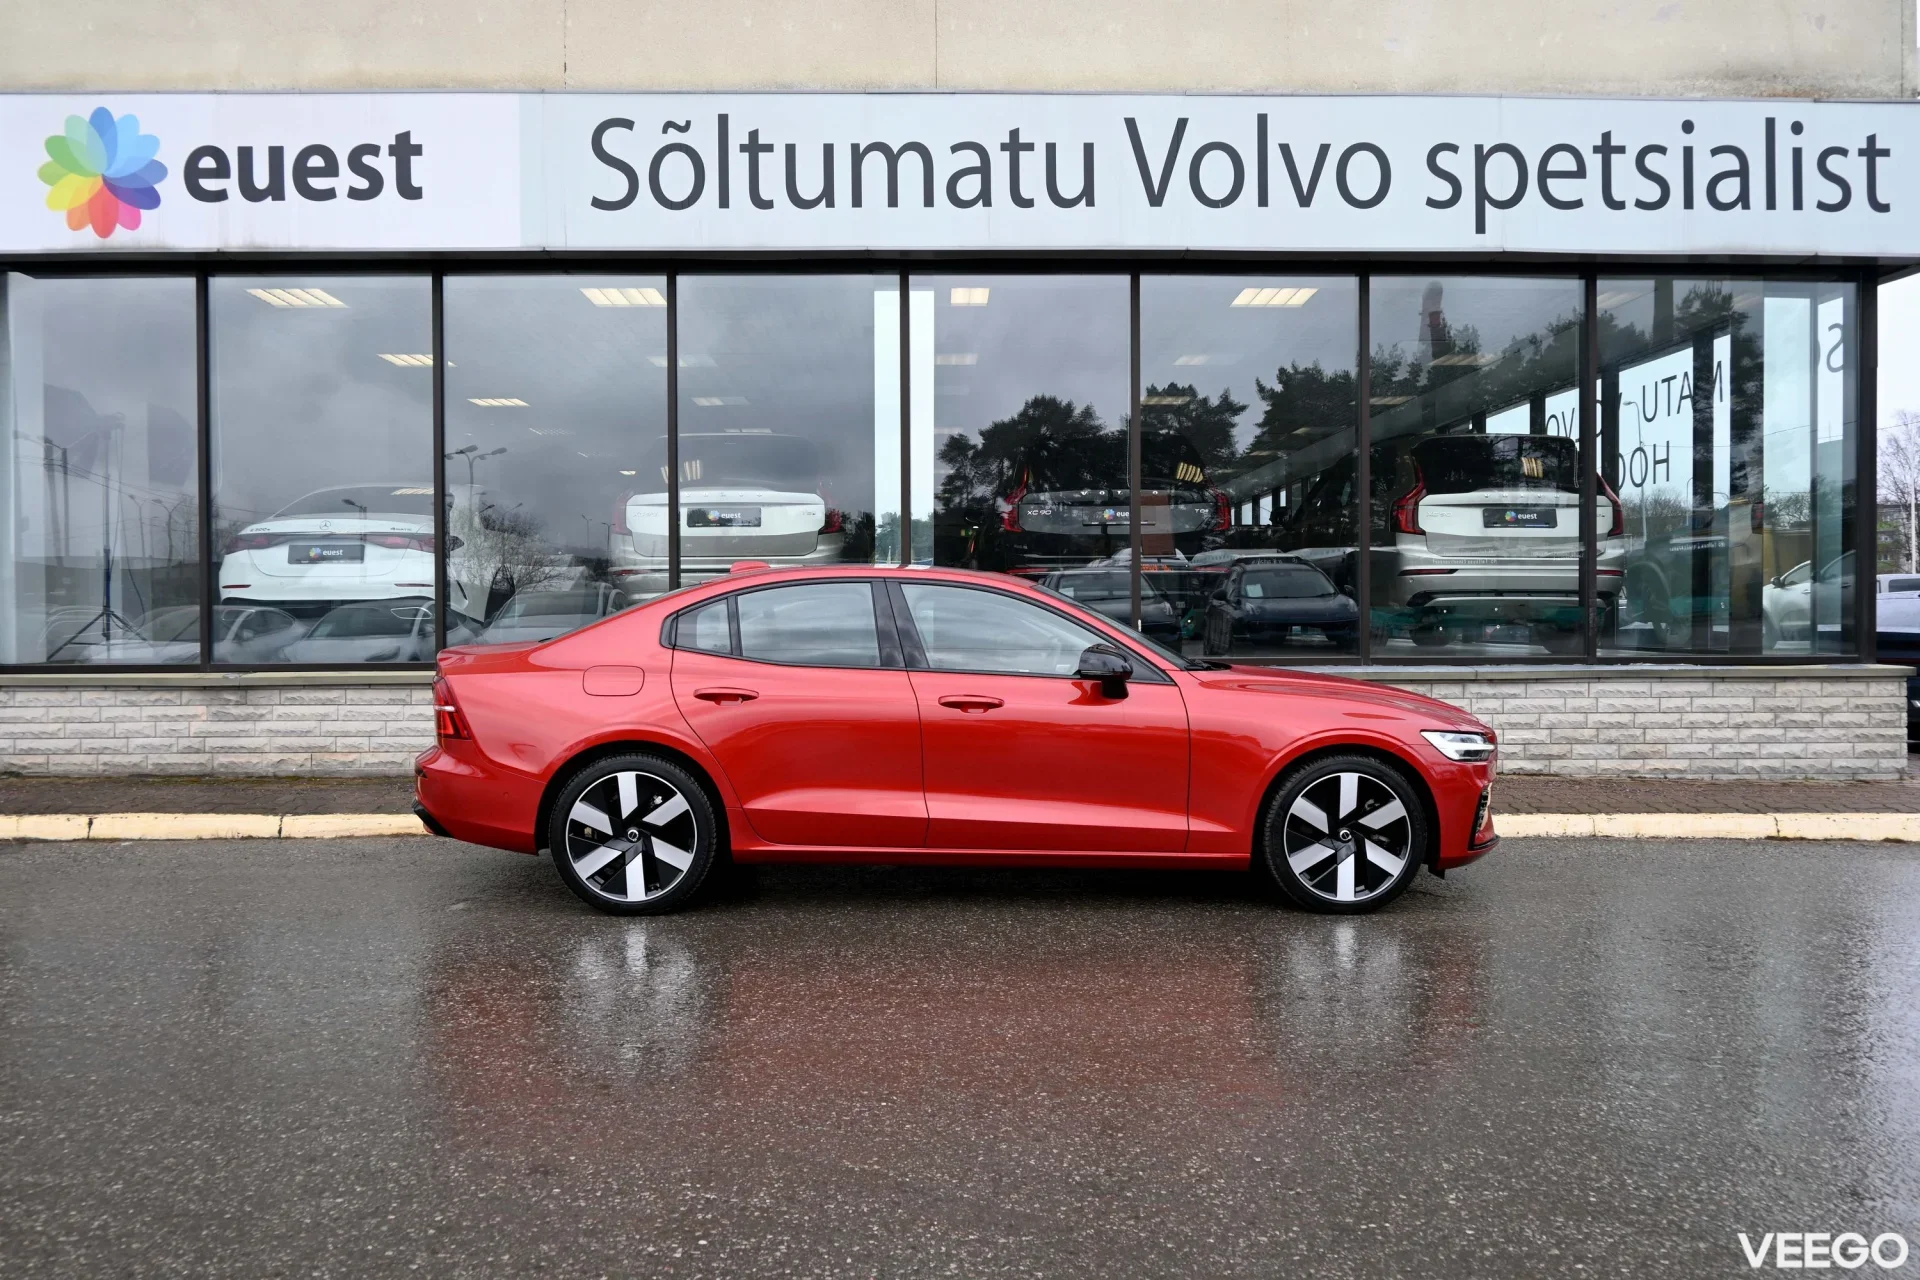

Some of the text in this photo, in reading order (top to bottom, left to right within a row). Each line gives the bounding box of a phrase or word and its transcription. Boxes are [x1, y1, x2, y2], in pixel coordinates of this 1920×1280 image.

[183, 130, 424, 203] euest
[590, 113, 1891, 235] Sõltumatu Volvo spetsialist
